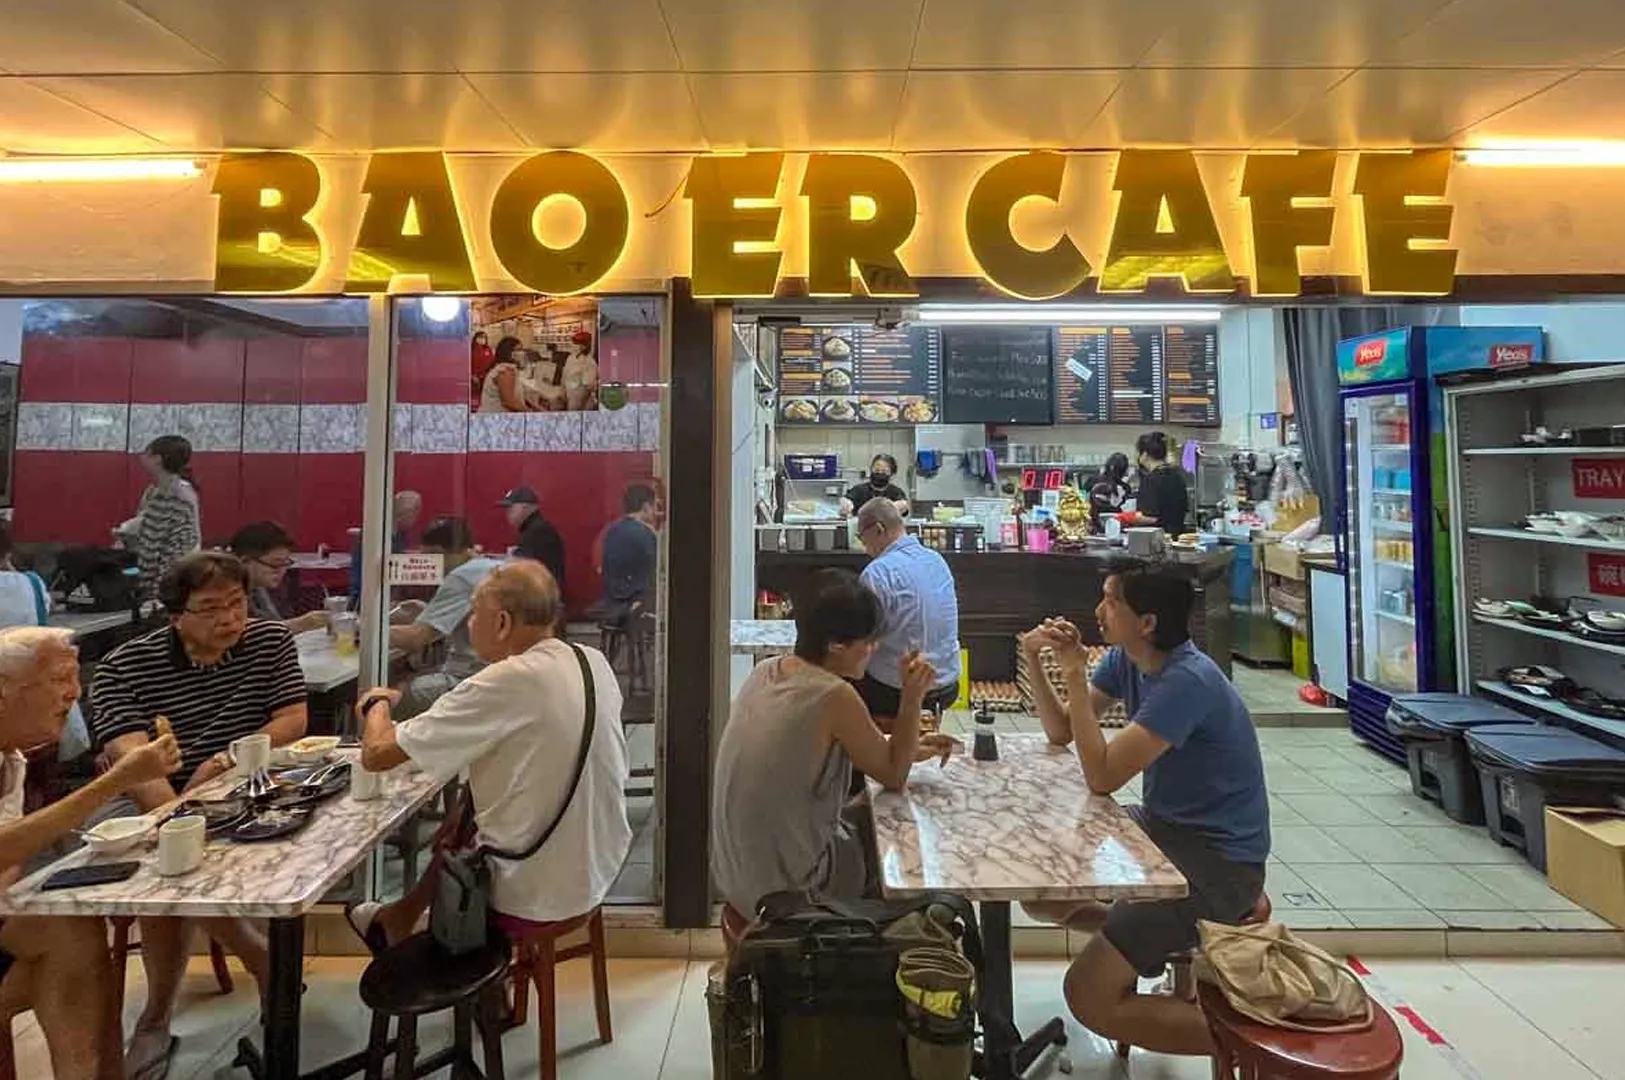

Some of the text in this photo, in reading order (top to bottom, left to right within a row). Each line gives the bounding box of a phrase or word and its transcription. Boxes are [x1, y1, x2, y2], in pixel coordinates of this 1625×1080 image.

[211, 149, 1459, 300] BAO ER CAFE
[1578, 468, 1625, 488] TRAY
